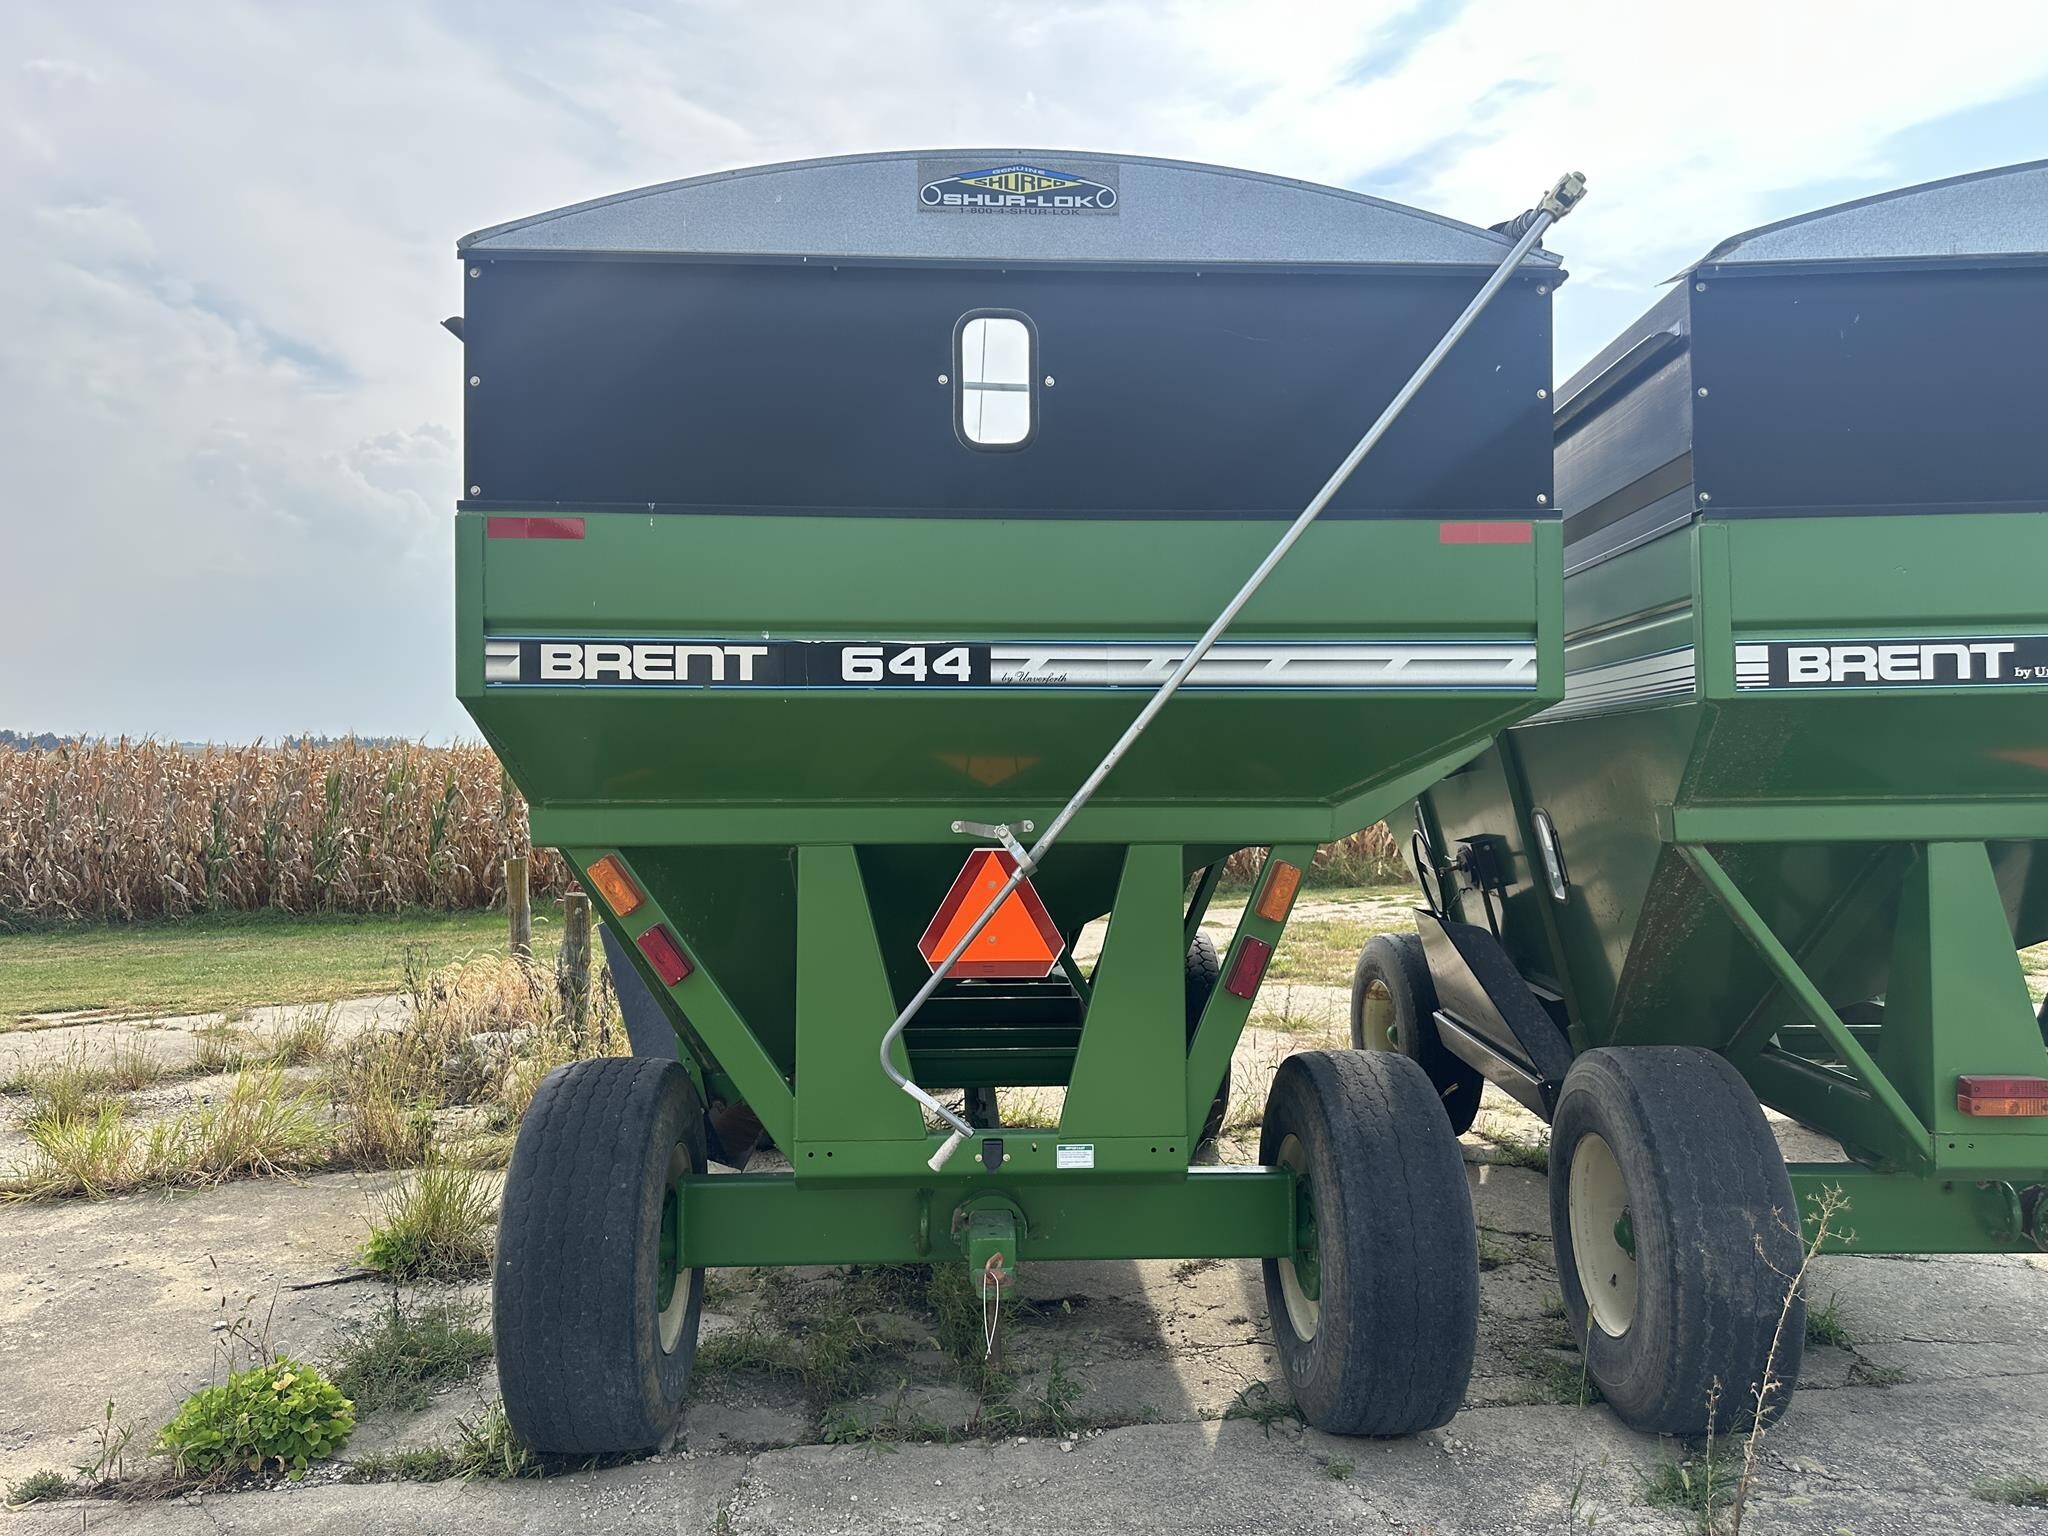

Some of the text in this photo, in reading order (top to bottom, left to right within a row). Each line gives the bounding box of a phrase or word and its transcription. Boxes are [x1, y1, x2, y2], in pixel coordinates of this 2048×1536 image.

[992, 165, 1046, 175] GENUINE
[974, 173, 1066, 193] SHURCO
[943, 193, 1094, 208] SHUR-LOK
[959, 207, 1080, 216] 1-800-4-SHUR-LOK
[540, 644, 972, 682] BRENT 644
[1787, 643, 2015, 682] BRENT
[2014, 666, 2032, 680] by
[1001, 671, 1068, 684] by Unverforth
